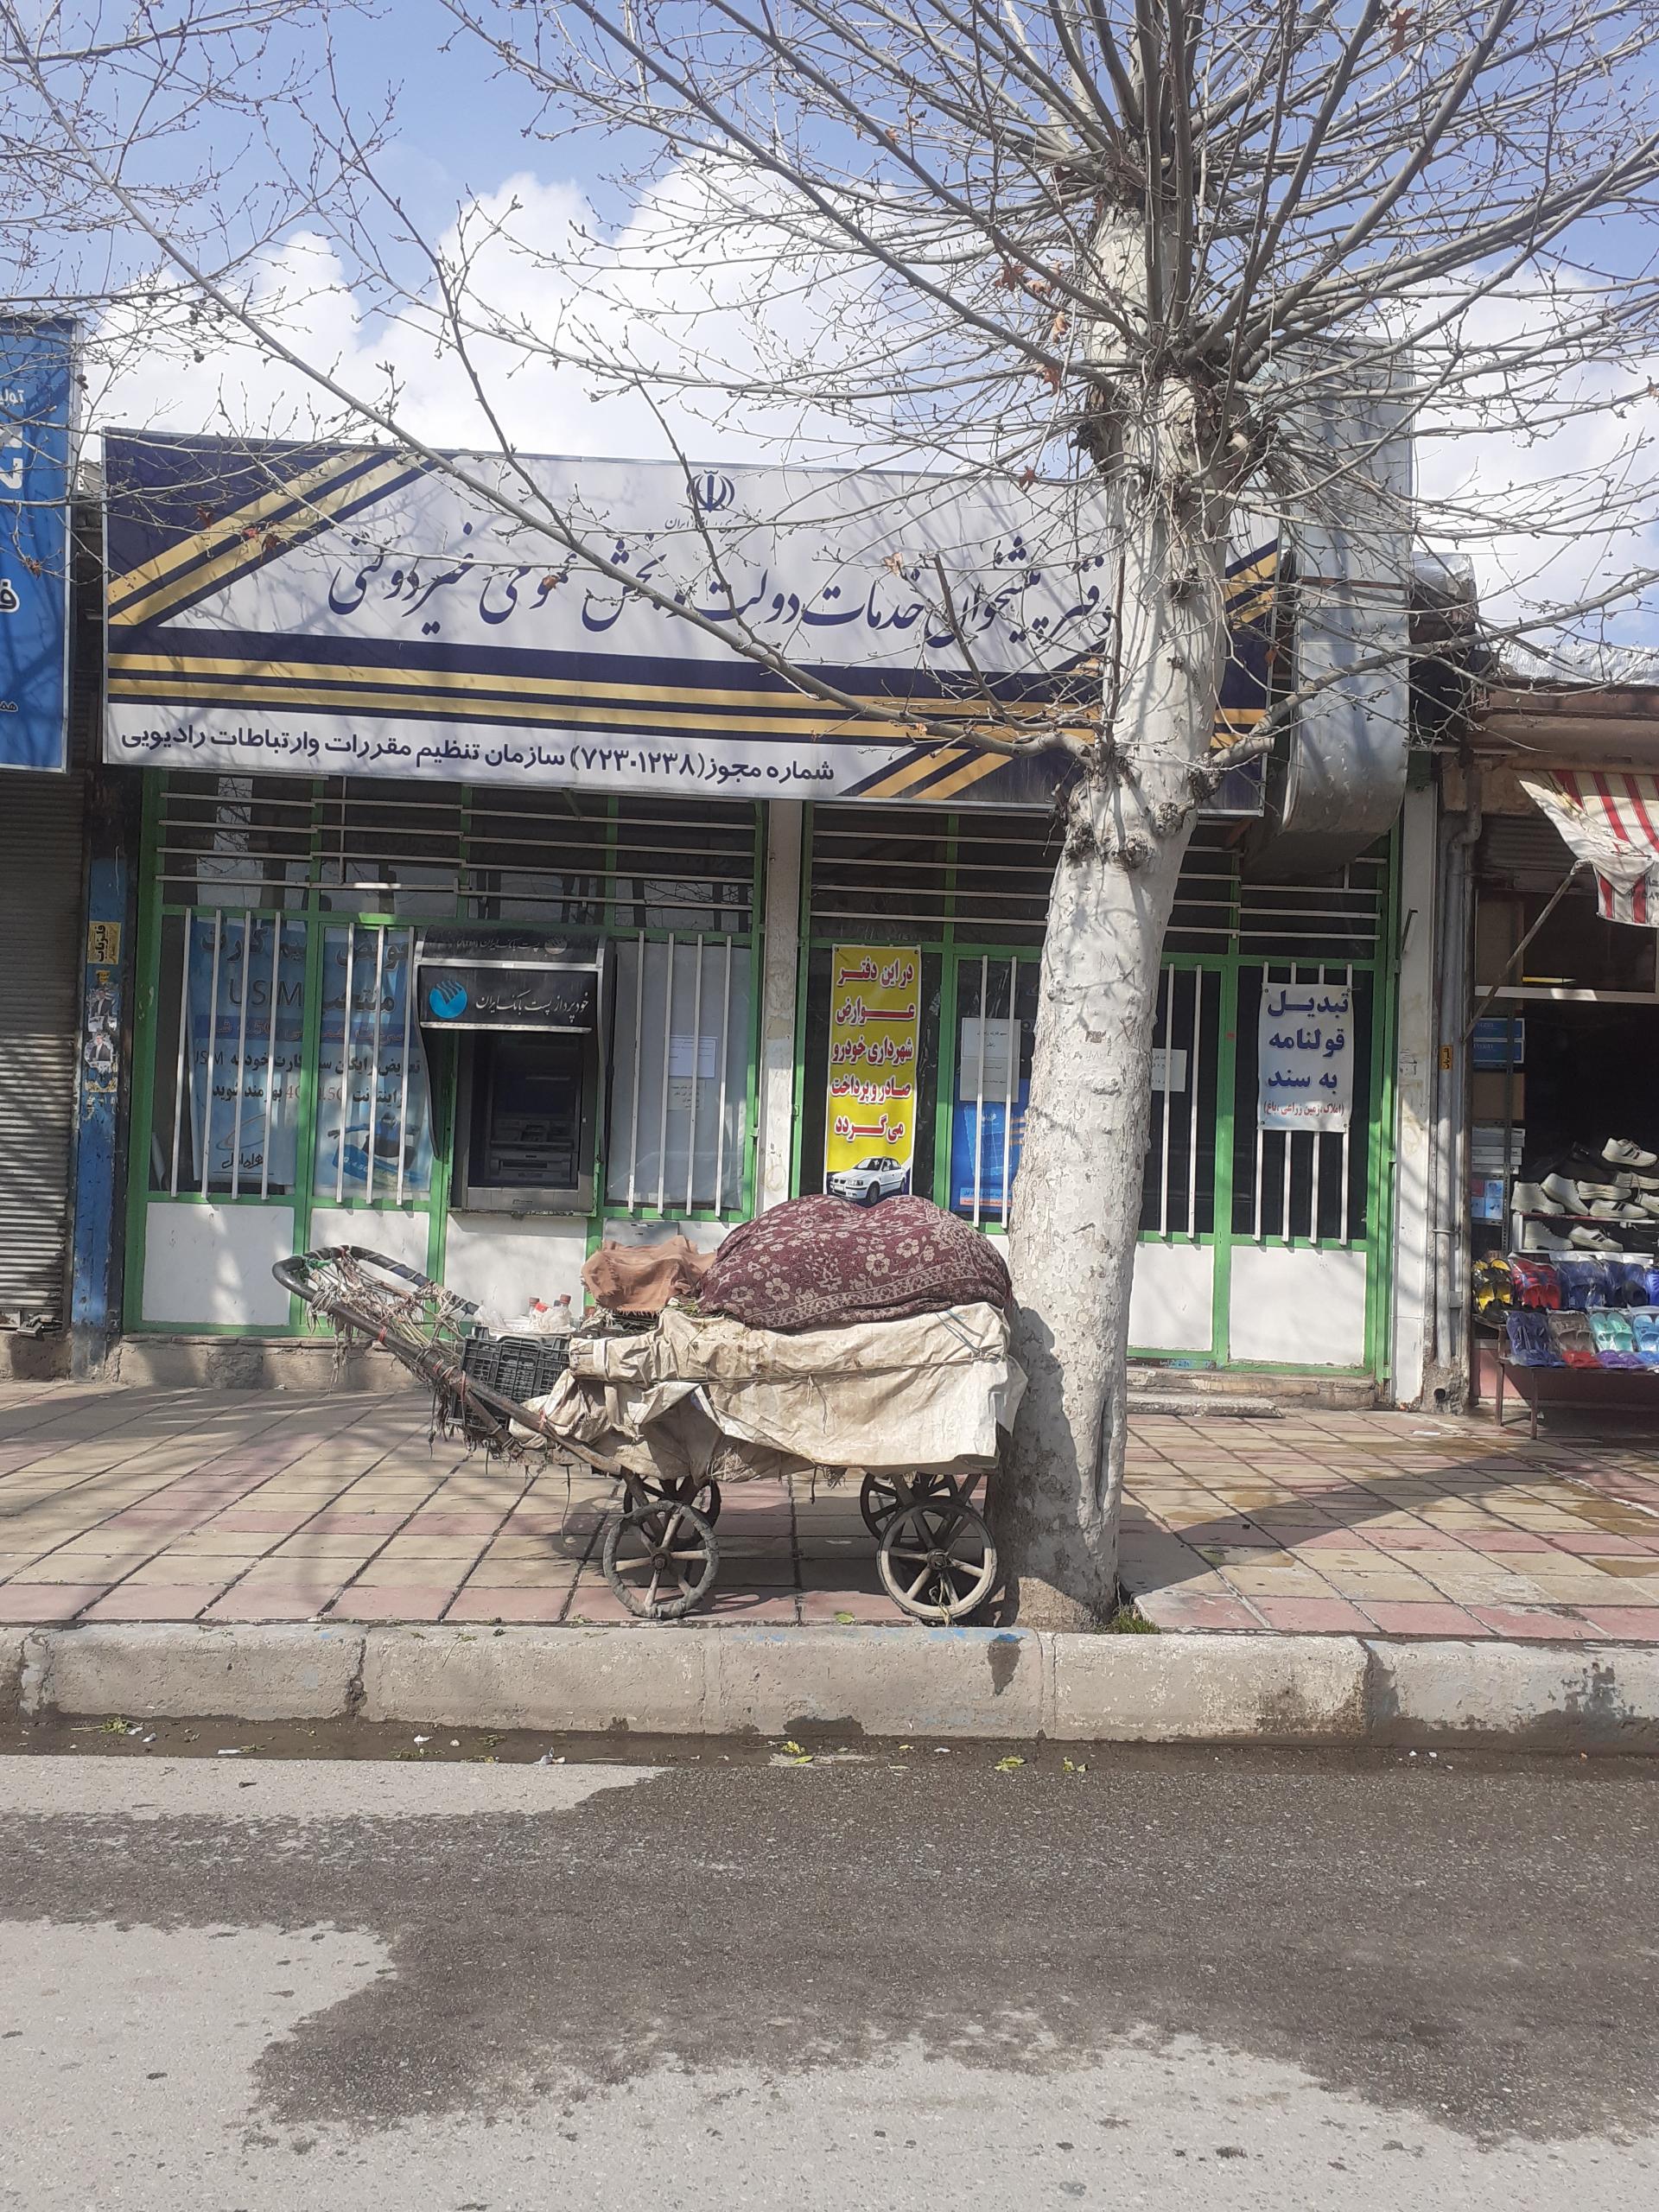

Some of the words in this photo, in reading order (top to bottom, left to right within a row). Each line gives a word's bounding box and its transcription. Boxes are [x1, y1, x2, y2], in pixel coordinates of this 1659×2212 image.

[690, 569, 800, 624] دولت
[800, 567, 925, 630] خدمات
[121, 724, 206, 749] رادیویی
[324, 734, 411, 760] مقررات
[416, 737, 480, 767] تنظیم
[485, 742, 565, 767] سازمان
[766, 760, 835, 785] شماره
[837, 956, 878, 986] دفتر
[880, 958, 899, 987] این
[899, 963, 914, 988] در
[475, 995, 499, 1014] ایران
[498, 989, 532, 1015] بانک
[524, 996, 552, 1015] پست
[836, 995, 916, 1025] عوارض
[1268, 990, 1349, 1019] تبدیل
[831, 1035, 867, 1064] خودرو
[868, 1035, 913, 1065] شهرداری
[1268, 1028, 1345, 1058] قولنامه
[831, 1074, 870, 1103] پرداخت
[879, 1075, 912, 1103] صادر
[1267, 1070, 1311, 1088] سند
[1319, 1071, 1338, 1095] به
[835, 1114, 888, 1141] گردد
[886, 1122, 906, 1143] می
